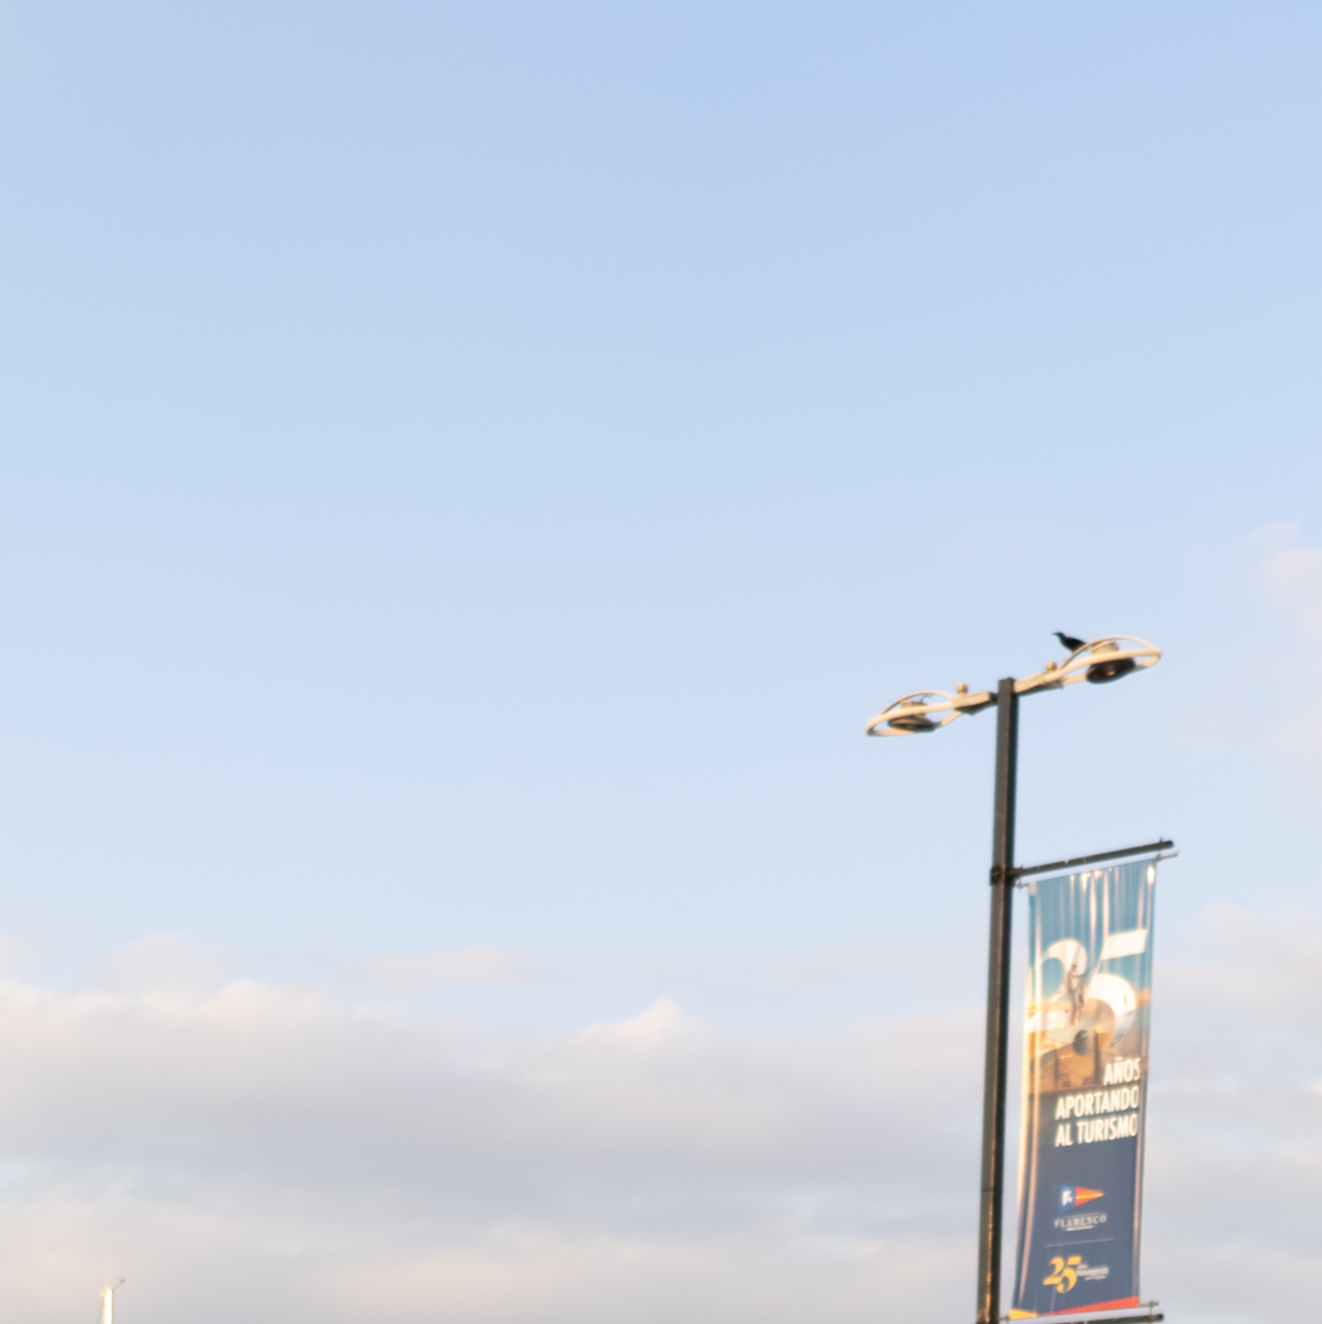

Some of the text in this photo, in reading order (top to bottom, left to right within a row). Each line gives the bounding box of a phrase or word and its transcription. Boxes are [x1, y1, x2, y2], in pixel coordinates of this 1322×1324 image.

[1103, 1057, 1141, 1086] AÑOS
[1055, 1085, 1139, 1120] APORTANDO
[1054, 1113, 1138, 1147] AL TURISMO
[1054, 1214, 1107, 1229] FLAMENCO
[1042, 1255, 1082, 1293] 25
